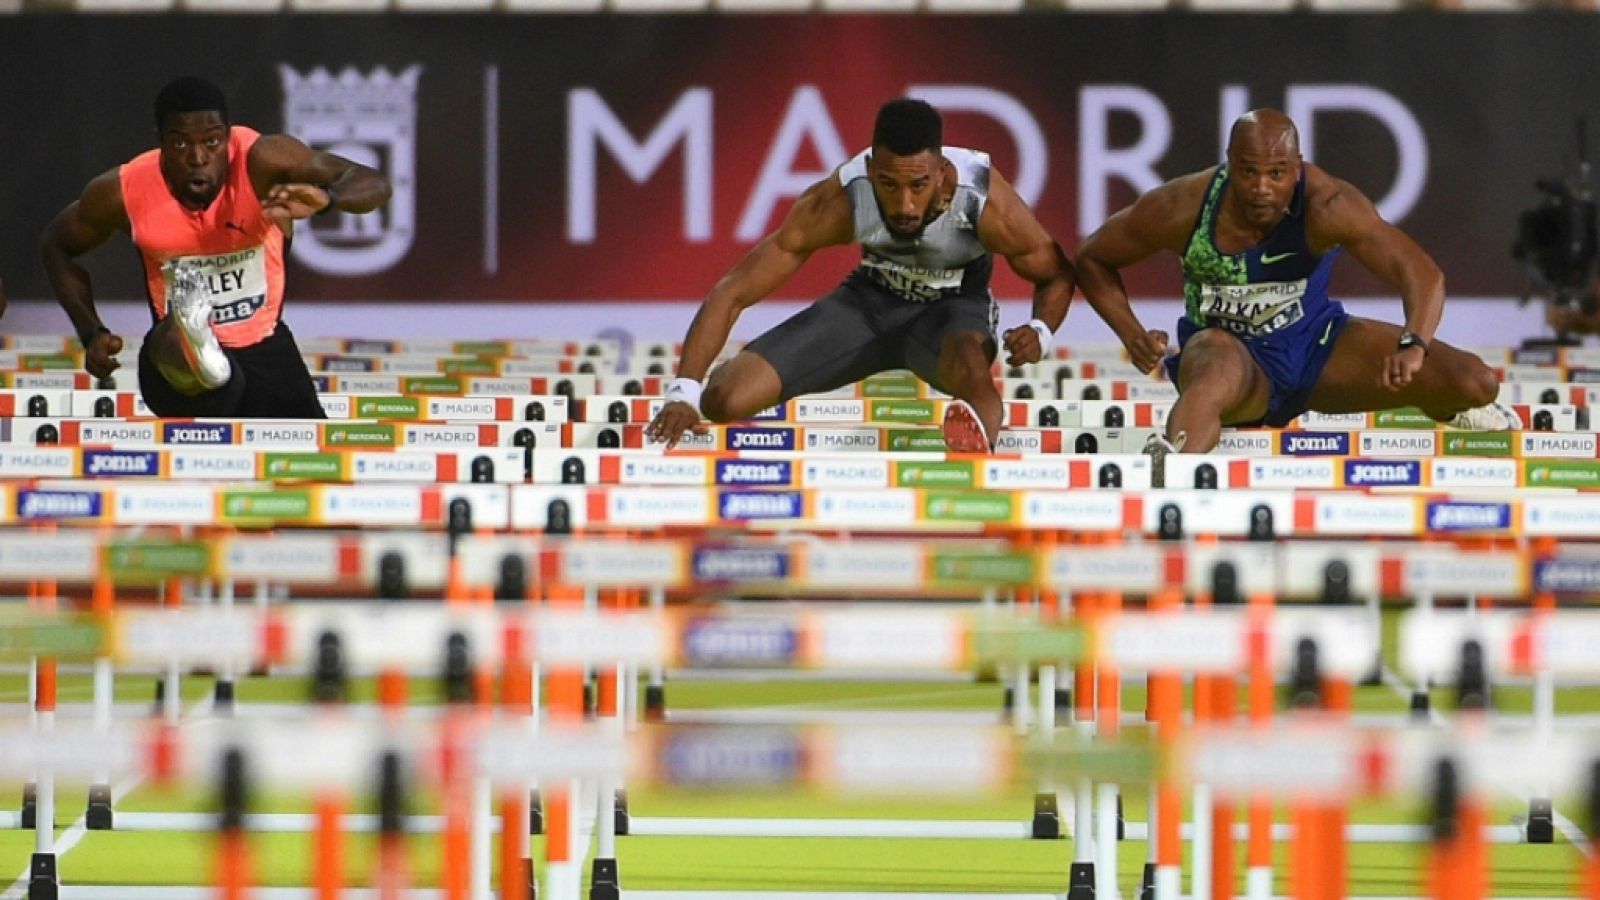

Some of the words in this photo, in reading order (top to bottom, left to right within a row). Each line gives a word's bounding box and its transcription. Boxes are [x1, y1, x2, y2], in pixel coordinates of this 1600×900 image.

[1231, 283, 1298, 299] MADRID
[446, 404, 492, 413] MADRID
[814, 405, 861, 414] MADRID
[100, 429, 151, 440] MADRID
[262, 430, 313, 441] MADRID
[424, 431, 475, 442] MADRID
[825, 435, 876, 446] MADRID
[998, 437, 1038, 448] ADRID
[1217, 437, 1269, 448] MADRID
[1380, 438, 1431, 448] MADRID
[1541, 441, 1594, 450] MADRID
[12, 456, 68, 467] MADRID
[194, 458, 250, 470] MADRID
[375, 460, 432, 472] MADRID
[1007, 467, 1065, 479] MADRID
